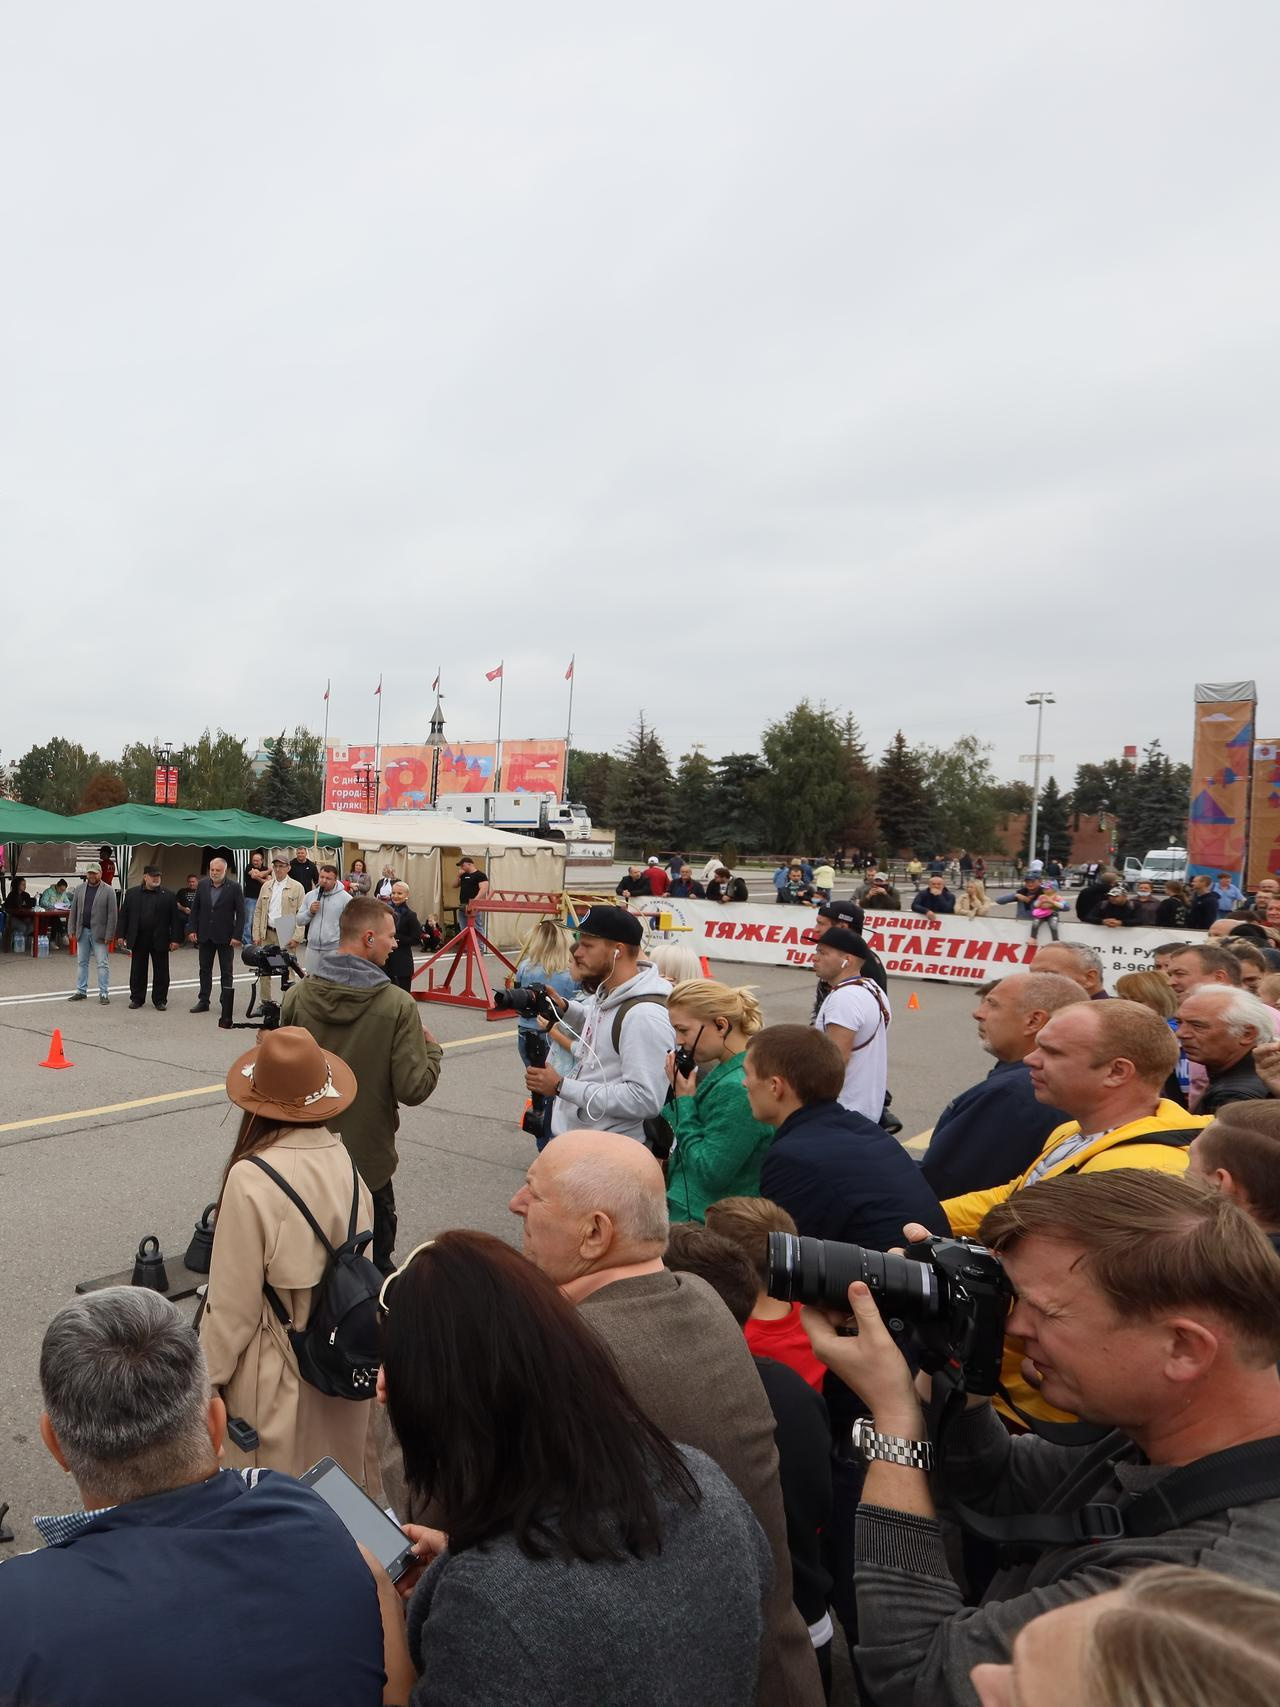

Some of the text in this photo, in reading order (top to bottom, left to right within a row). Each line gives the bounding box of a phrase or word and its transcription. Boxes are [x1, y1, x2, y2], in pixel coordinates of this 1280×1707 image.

[332, 789, 362, 798] город
[864, 914, 942, 931] ерация
[704, 920, 819, 946] ТЯЖЕЛО
[886, 959, 985, 979] области
